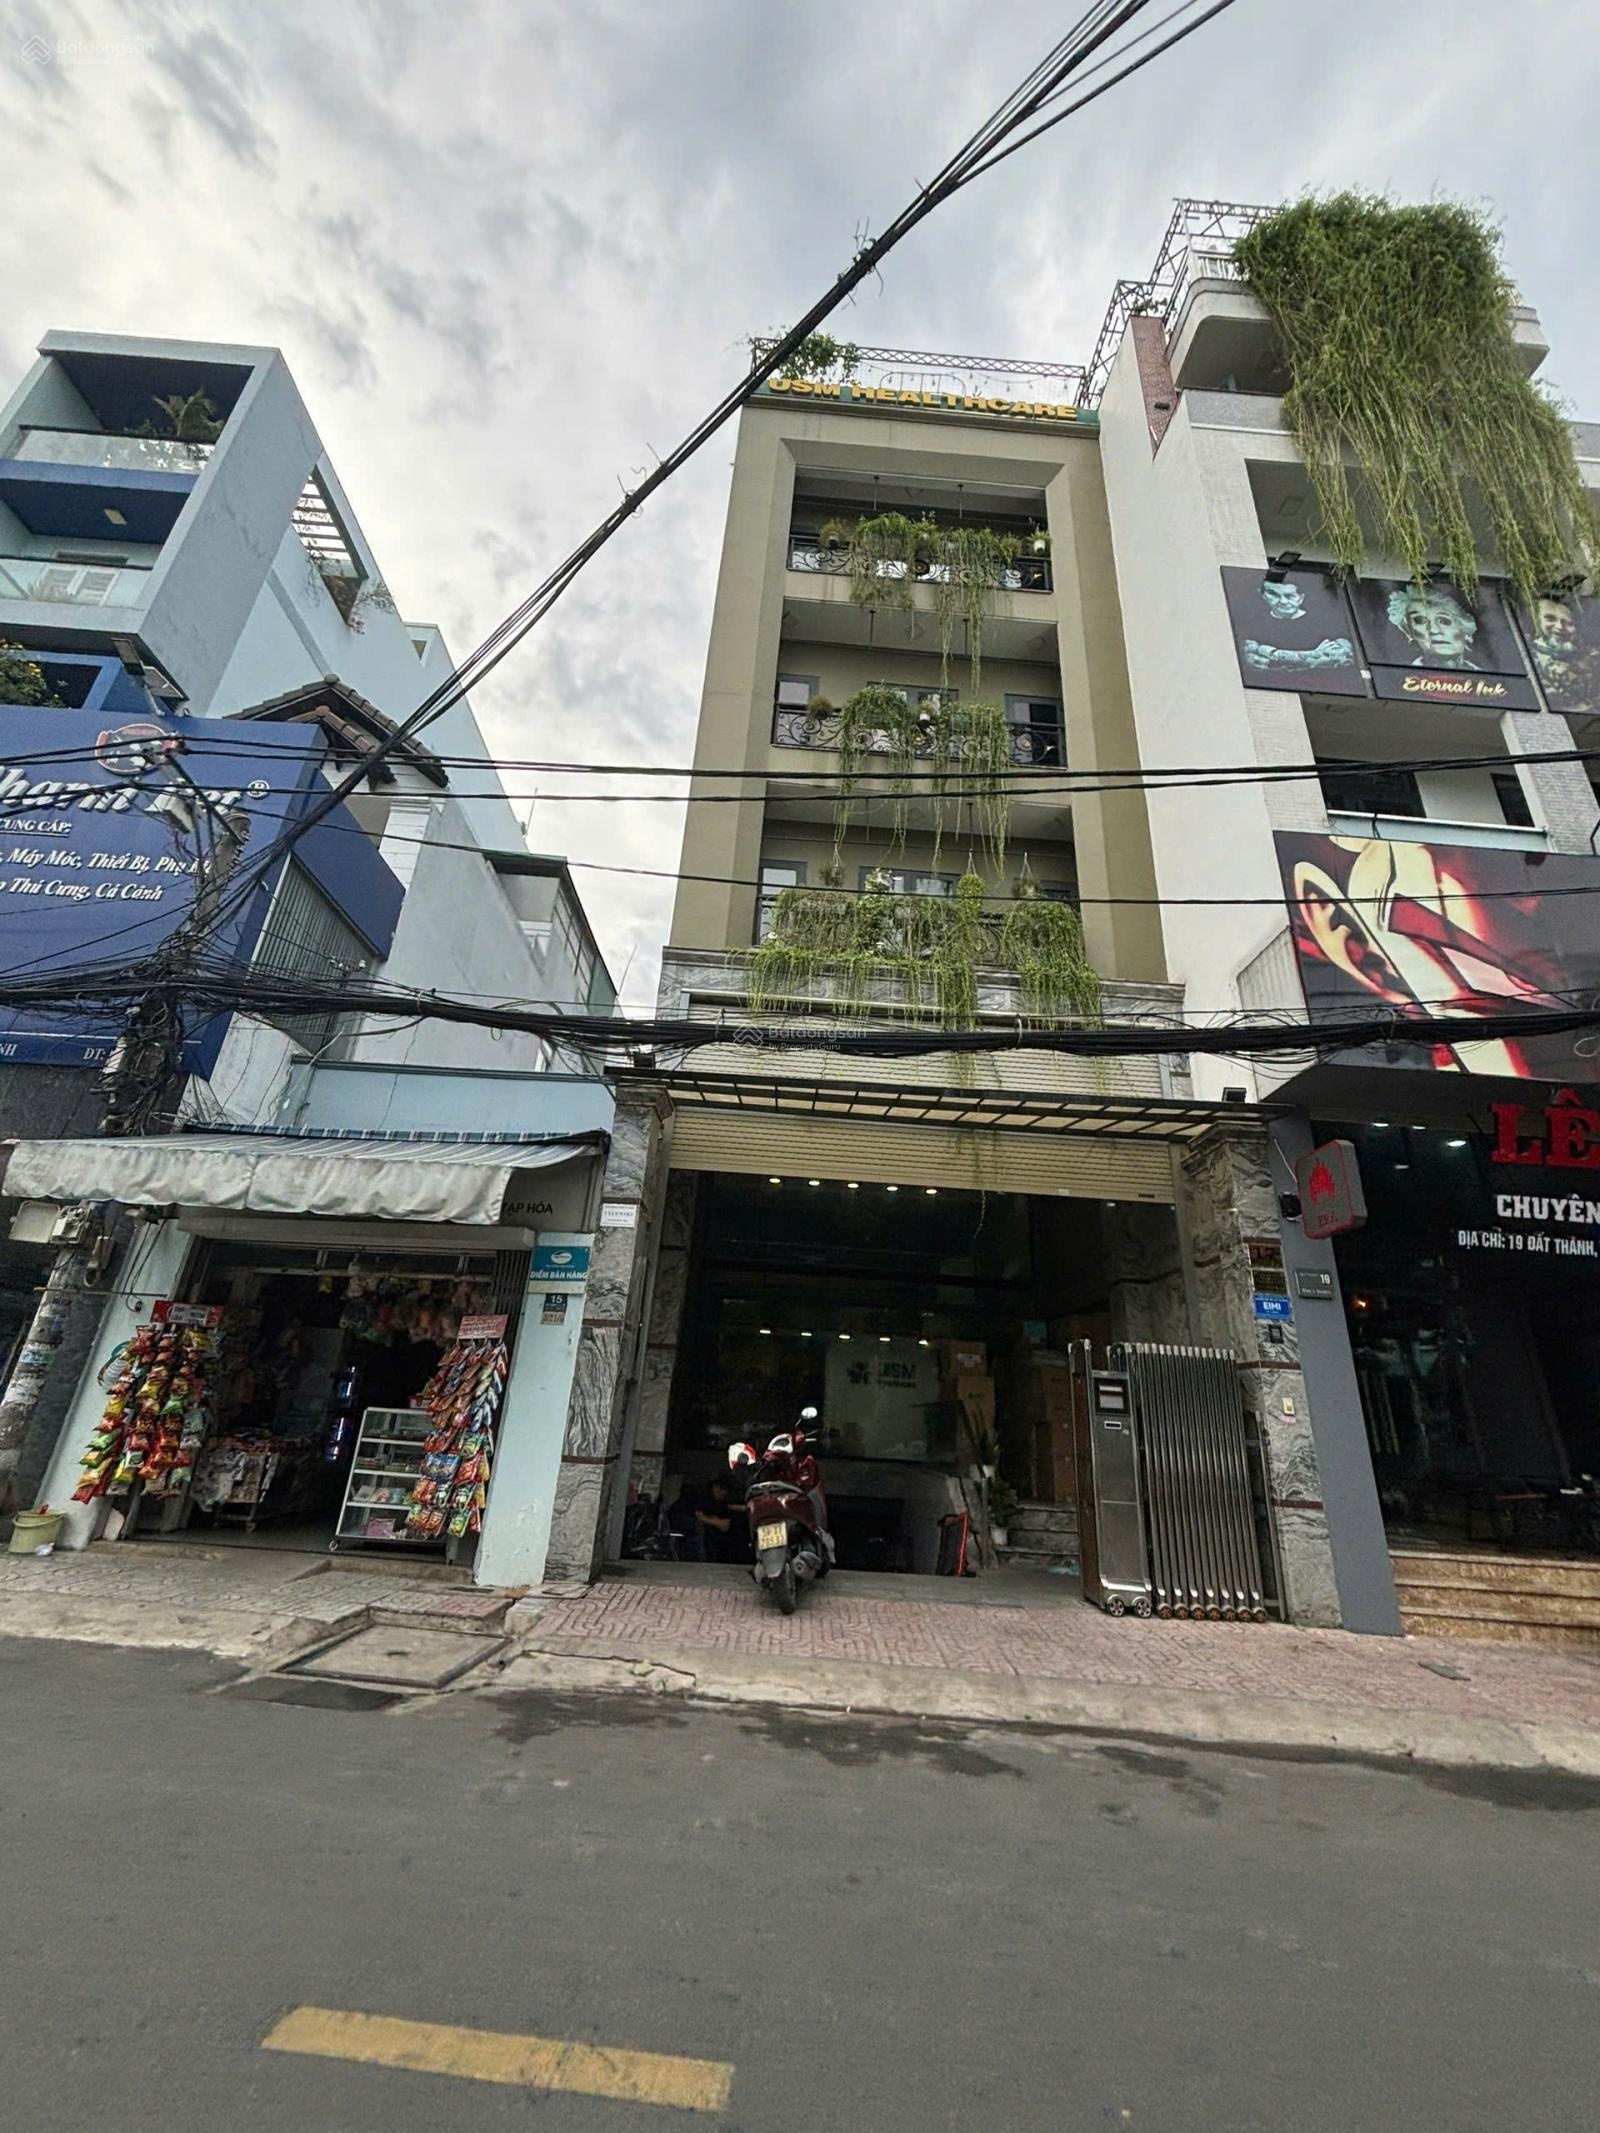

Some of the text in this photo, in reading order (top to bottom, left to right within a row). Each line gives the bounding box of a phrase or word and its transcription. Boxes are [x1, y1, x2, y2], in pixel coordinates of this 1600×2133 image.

[768, 377, 1079, 420] USM HEALTHCARE
[1403, 676, 1508, 696] Eternal Ink
[7, 848, 44, 868] Máy
[95, 882, 120, 899] Cá
[1490, 1088, 1600, 1168] LÊ
[1458, 1230, 1479, 1249] ĐỊA
[1509, 1234, 1523, 1250] 19
[1320, 1274, 1331, 1285] 19
